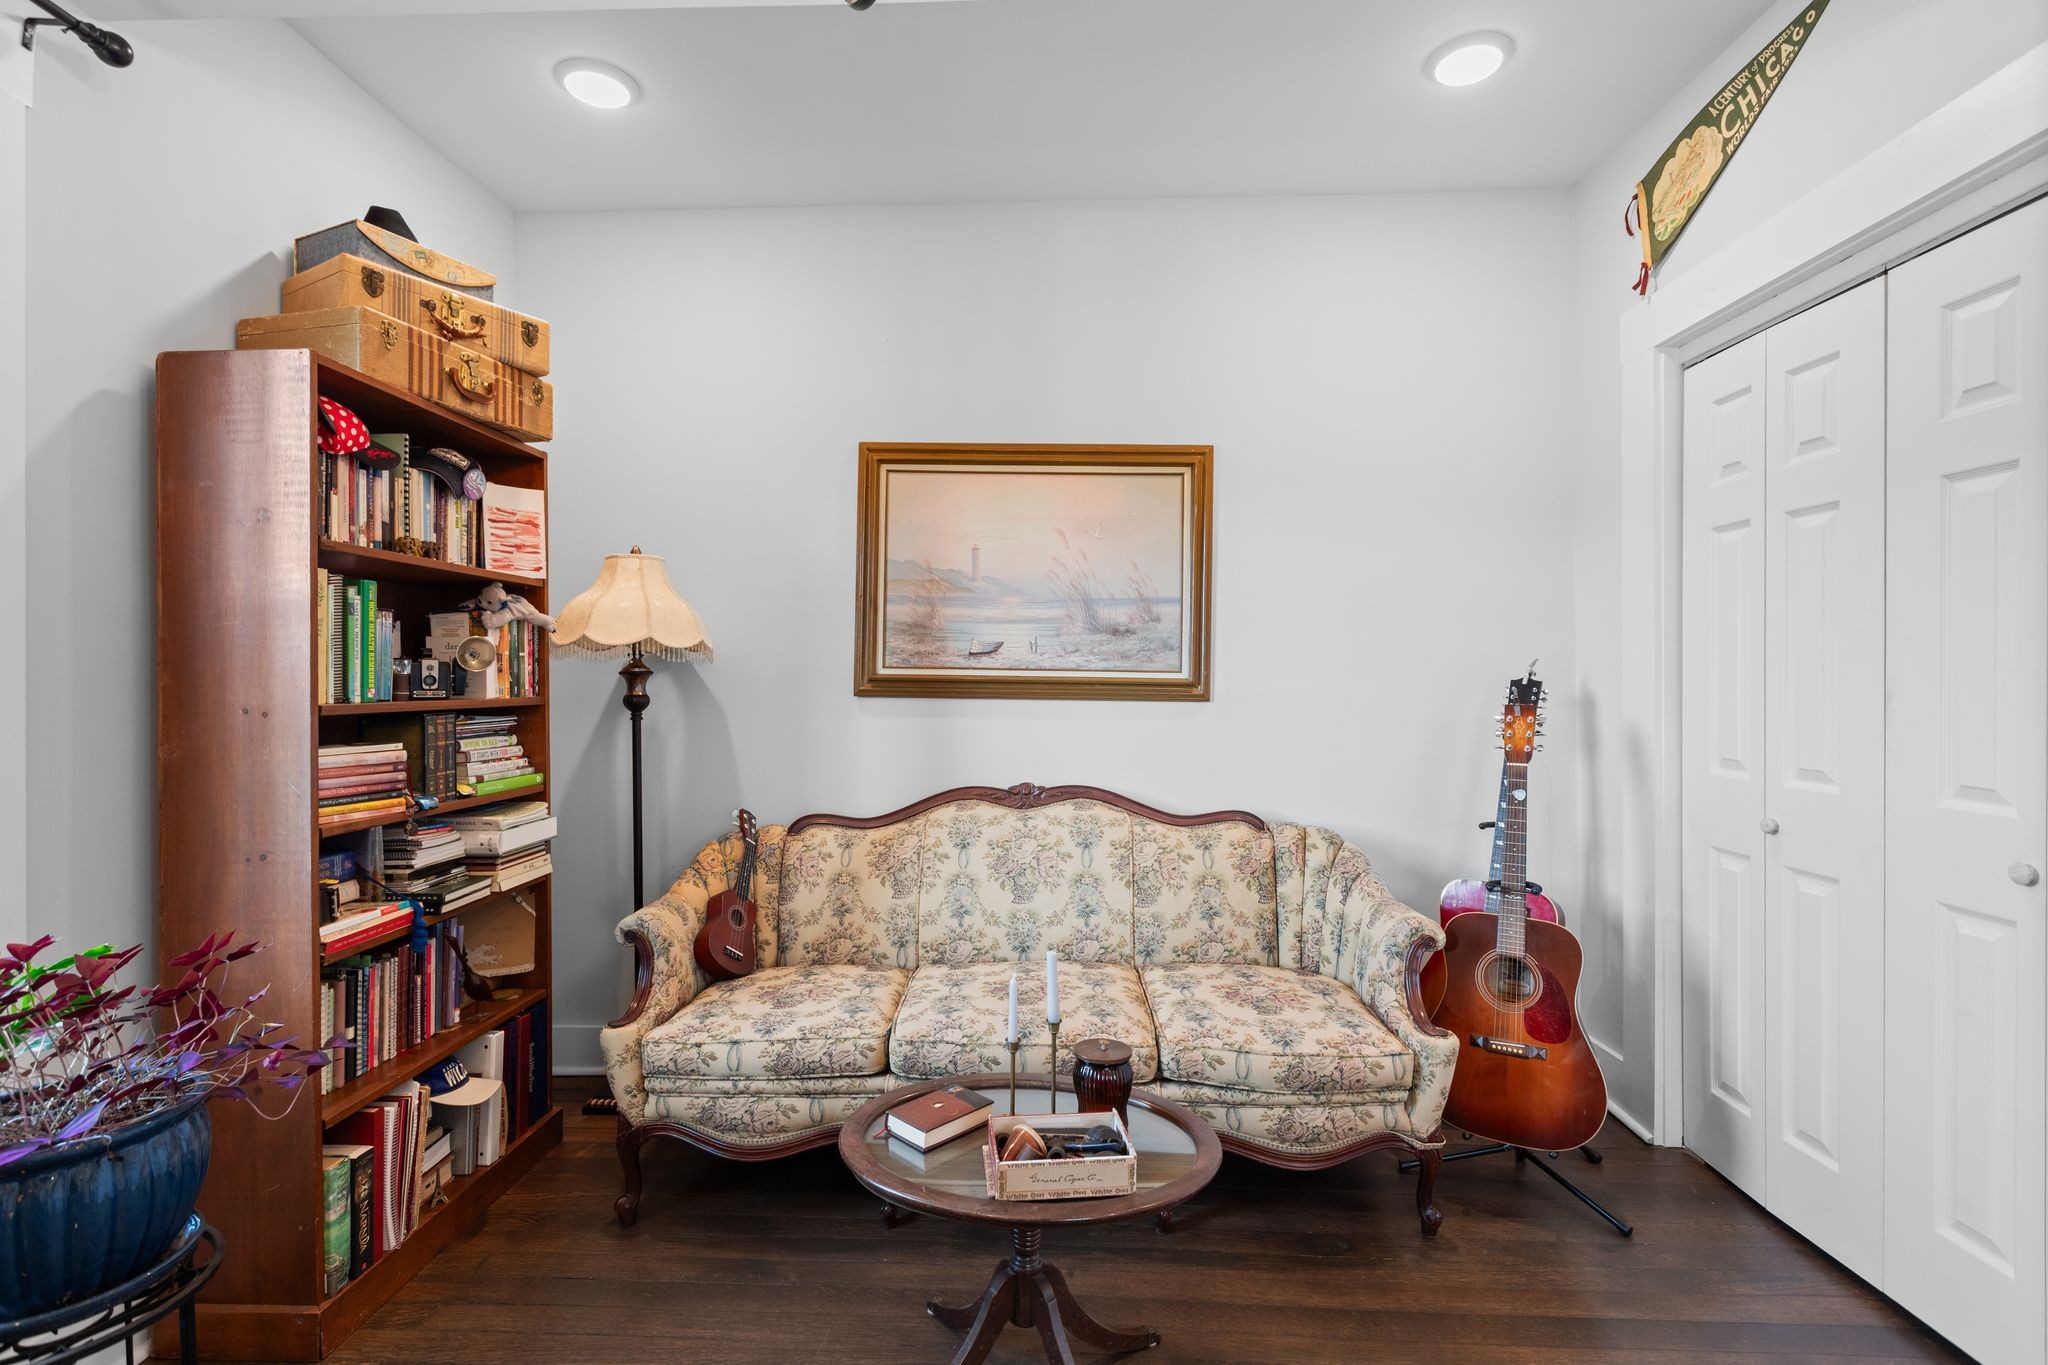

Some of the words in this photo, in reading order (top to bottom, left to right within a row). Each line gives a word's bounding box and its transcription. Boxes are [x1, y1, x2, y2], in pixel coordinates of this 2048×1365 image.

[1708, 106, 1717, 117] A
[1714, 69, 1752, 110] CENTURY
[1751, 60, 1759, 73] of
[1758, 25, 1795, 63] PROGRESS
[1721, 10, 1815, 138] CHICAGO
[1726, 105, 1760, 155] WORLDS
